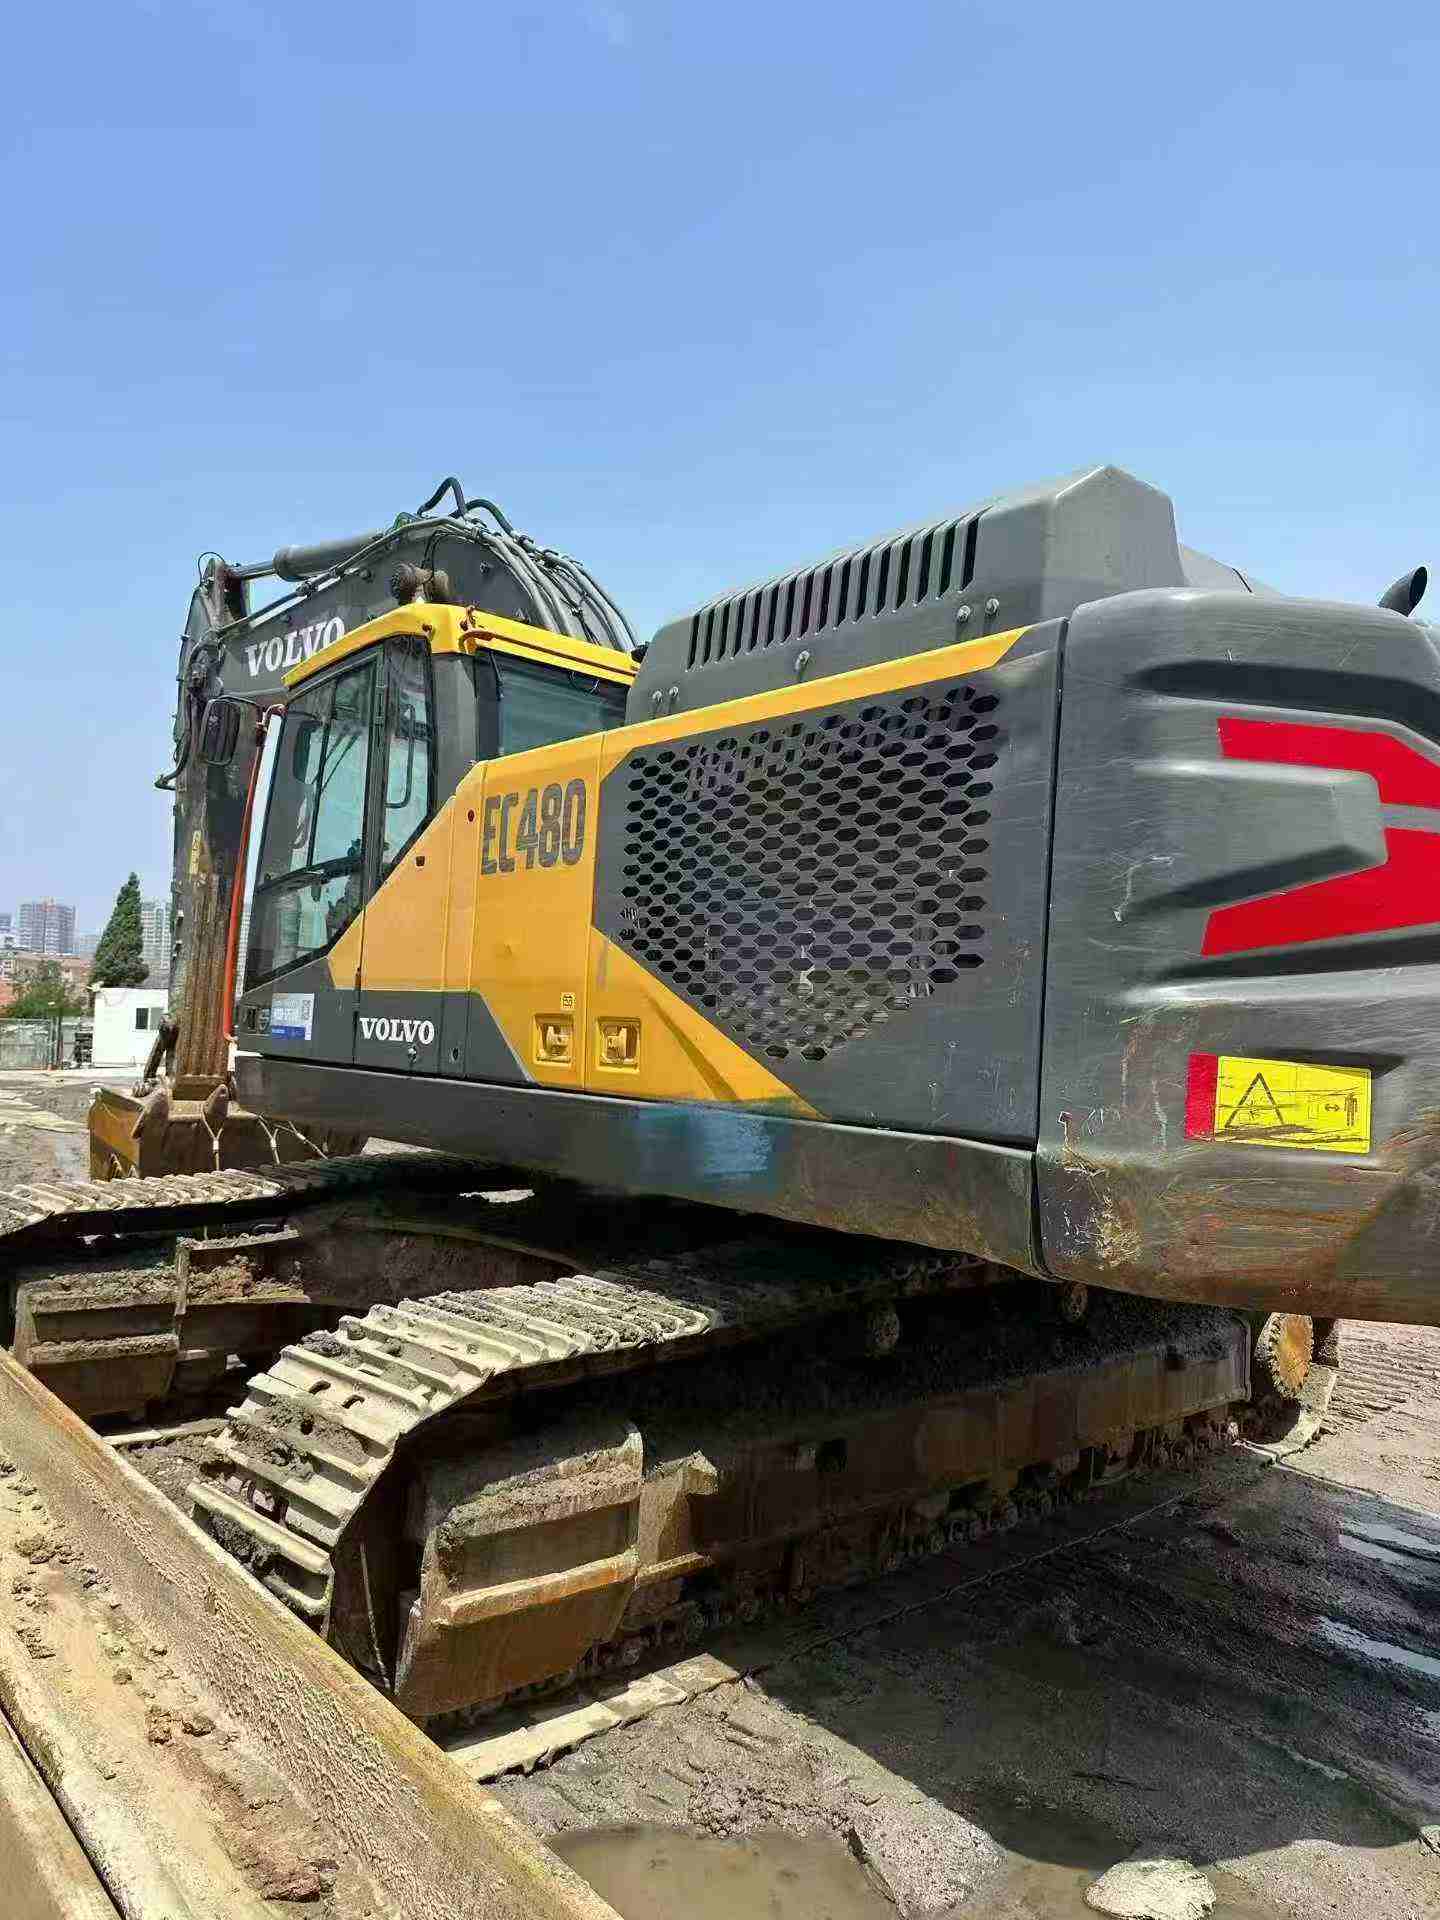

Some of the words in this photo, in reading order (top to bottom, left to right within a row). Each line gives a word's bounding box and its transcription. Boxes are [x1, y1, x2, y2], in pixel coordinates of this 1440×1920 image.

[245, 617, 345, 676] VOLVO
[481, 779, 586, 875] EC480
[360, 1017, 434, 1045] VOLVO
